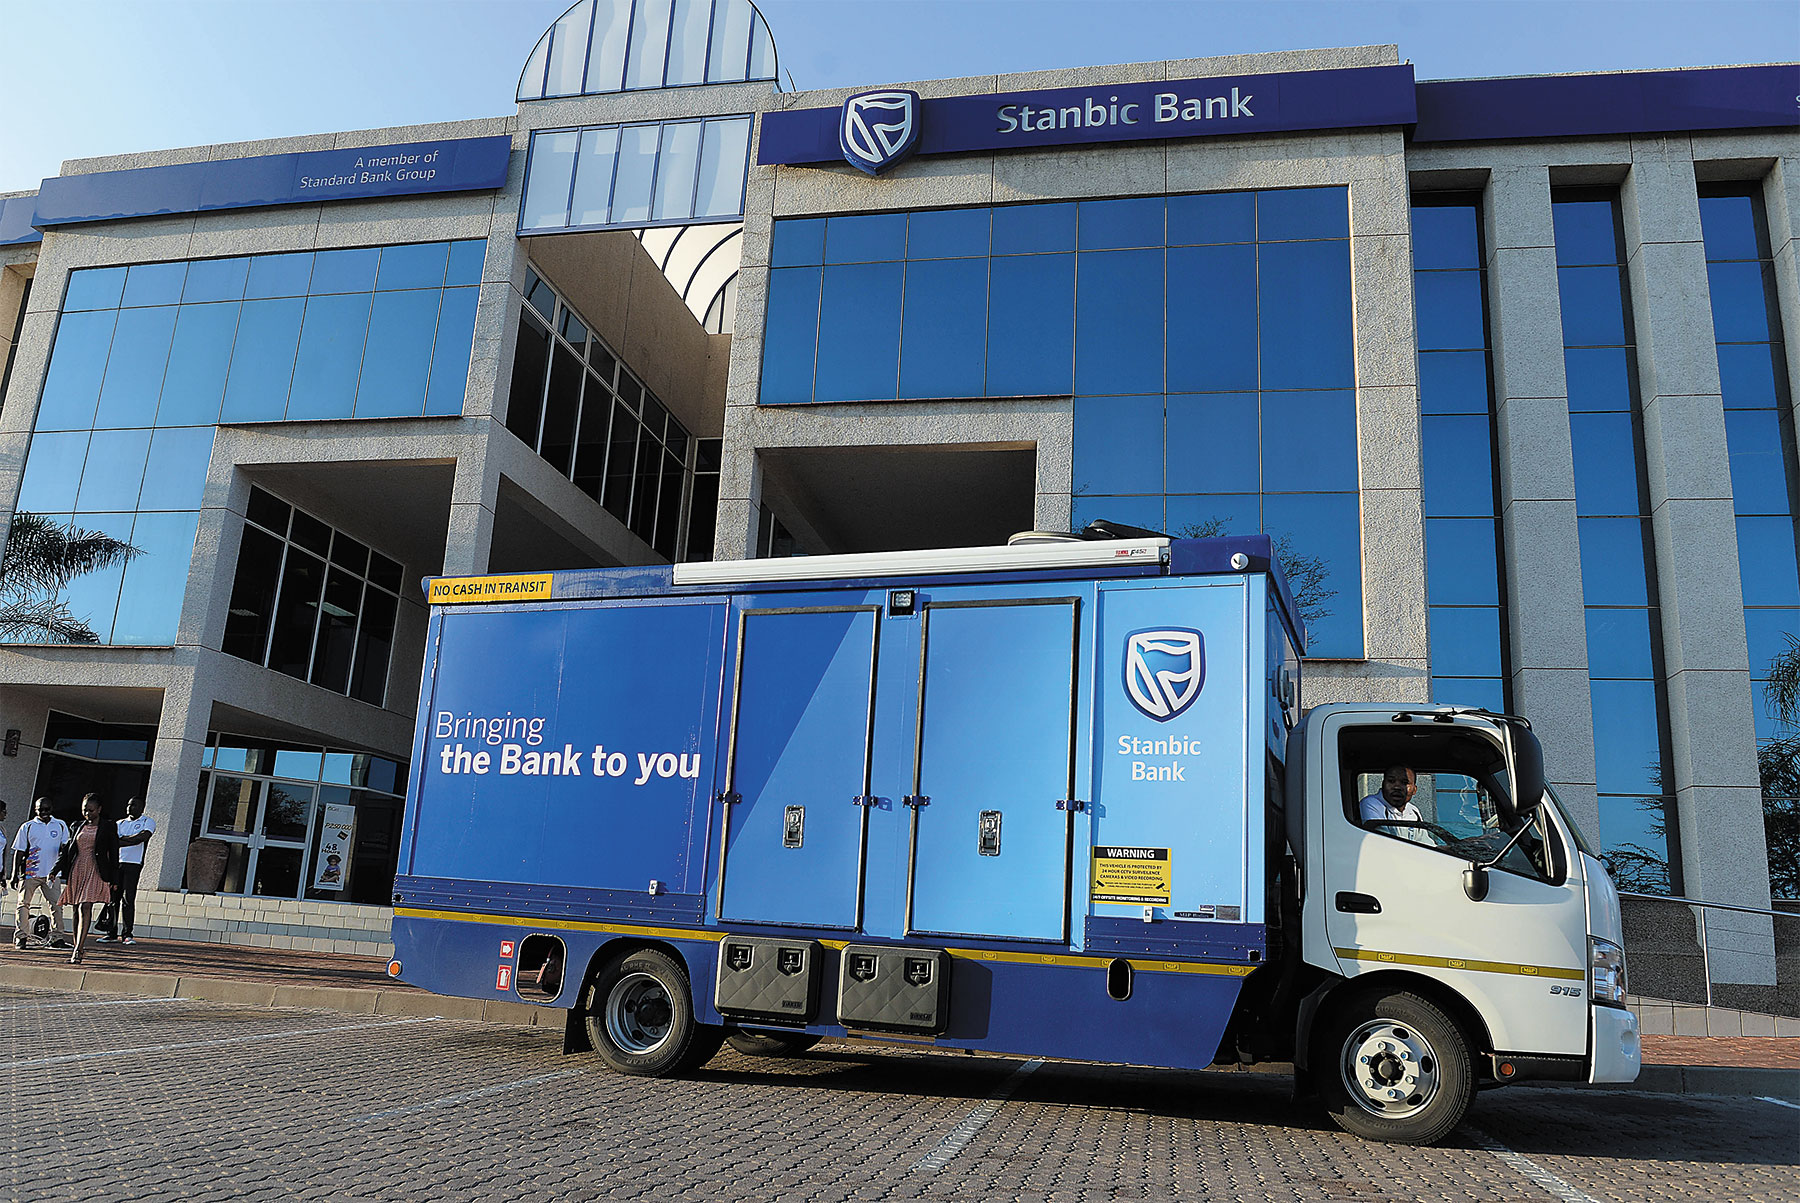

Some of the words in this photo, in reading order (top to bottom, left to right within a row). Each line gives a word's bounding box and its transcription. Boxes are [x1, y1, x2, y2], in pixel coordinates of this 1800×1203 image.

[996, 95, 1139, 133] Stanbic
[1154, 87, 1254, 122] Bank
[354, 157, 364, 168] A
[368, 153, 421, 168] member
[424, 150, 439, 163] of
[300, 173, 356, 188] Standard
[360, 171, 392, 184] Bank
[396, 168, 436, 182] Group
[433, 585, 450, 596] NO
[452, 584, 481, 595] CASH
[484, 583, 497, 594] IN
[499, 581, 546, 593] TRANSIT
[435, 711, 545, 745] Bringing
[1118, 735, 1201, 755] Stanbic
[440, 744, 491, 775] the
[500, 744, 582, 776] Bank
[592, 745, 627, 776] to
[634, 752, 701, 786] you
[1131, 761, 1185, 781] Bank
[325, 842, 338, 851] 48
[1107, 848, 1155, 858] WARNING
[1550, 985, 1581, 997] 915
